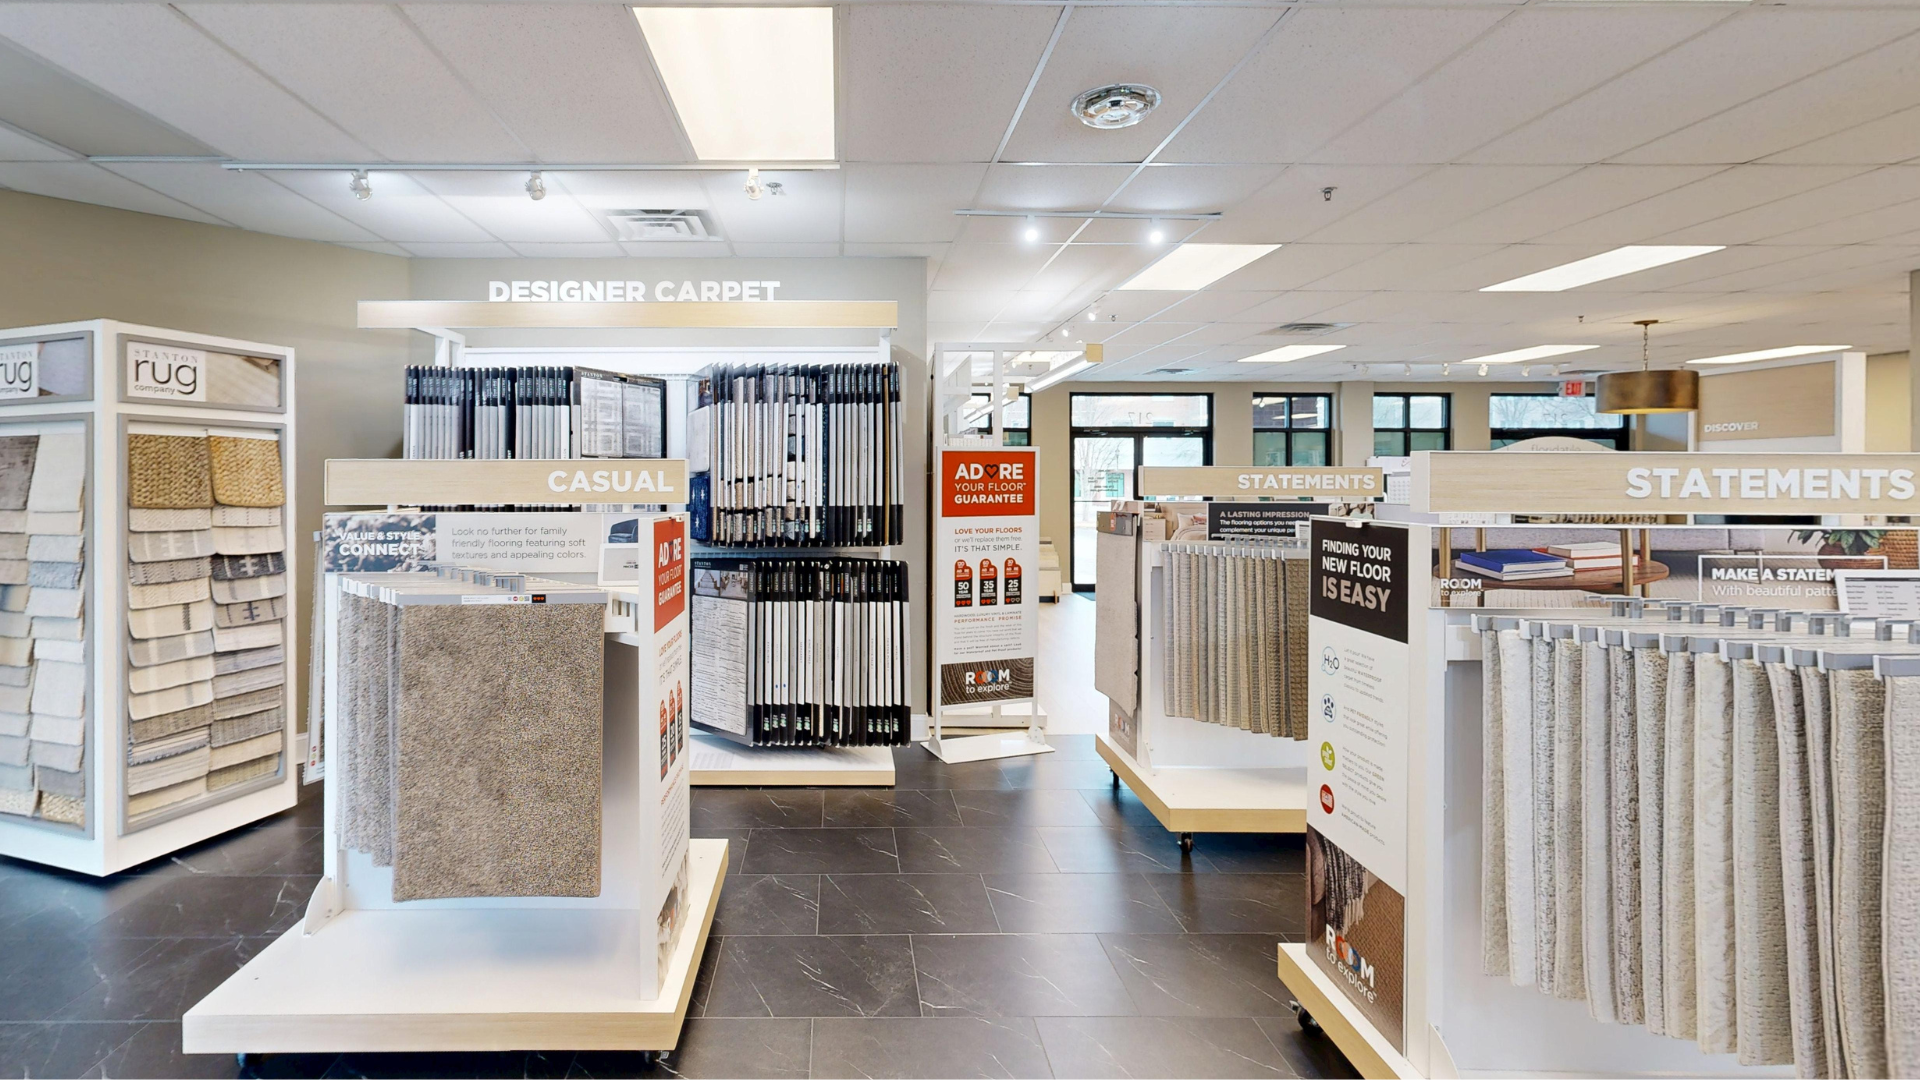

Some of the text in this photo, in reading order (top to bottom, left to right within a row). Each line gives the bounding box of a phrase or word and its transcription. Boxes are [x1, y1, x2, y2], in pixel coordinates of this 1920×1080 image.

[489, 281, 780, 302] DESIGNER CARPET
[0, 351, 32, 360] TANTON
[134, 349, 198, 363] STANTON
[135, 360, 196, 395] rug
[134, 384, 175, 395] company
[1704, 422, 1759, 432] DISCOVER
[548, 470, 674, 492] CASUAL
[955, 483, 984, 491] YOUR
[1238, 474, 1375, 490] STATEMENTS
[1626, 468, 1915, 500] STATEMENTS
[955, 494, 1023, 504] GUARANTEE
[1231, 519, 1252, 527] flooring
[339, 532, 421, 540] VALUE & STYLE
[541, 527, 567, 536] family
[452, 538, 586, 548] friendly flooring featuring soft
[339, 544, 420, 556] CONNECT
[491, 551, 508, 559] and
[510, 551, 554, 560] appealing
[557, 551, 586, 559] colors.
[1322, 539, 1391, 562] FINDING YOUR
[1322, 556, 1391, 583] NEW FLOOR
[1712, 568, 1758, 581] MAKE
[1762, 569, 1773, 581] A
[658, 570, 670, 587] YOUR
[1440, 579, 1482, 589] ROOM
[958, 582, 969, 590] 50
[984, 581, 994, 589] 35
[1712, 585, 1743, 596] With
[1746, 585, 1801, 597] beautiful
[658, 580, 682, 606] GUARANTEE
[1322, 575, 1391, 613] IS EASY
[966, 669, 1010, 685] ROOM
[1358, 670, 1382, 682] WATERPROOF
[966, 685, 975, 694] to
[1342, 763, 1355, 773] SELECT
[1372, 771, 1385, 781] GREEN
[1326, 923, 1375, 988] ROOM
[1326, 949, 1336, 965] to
